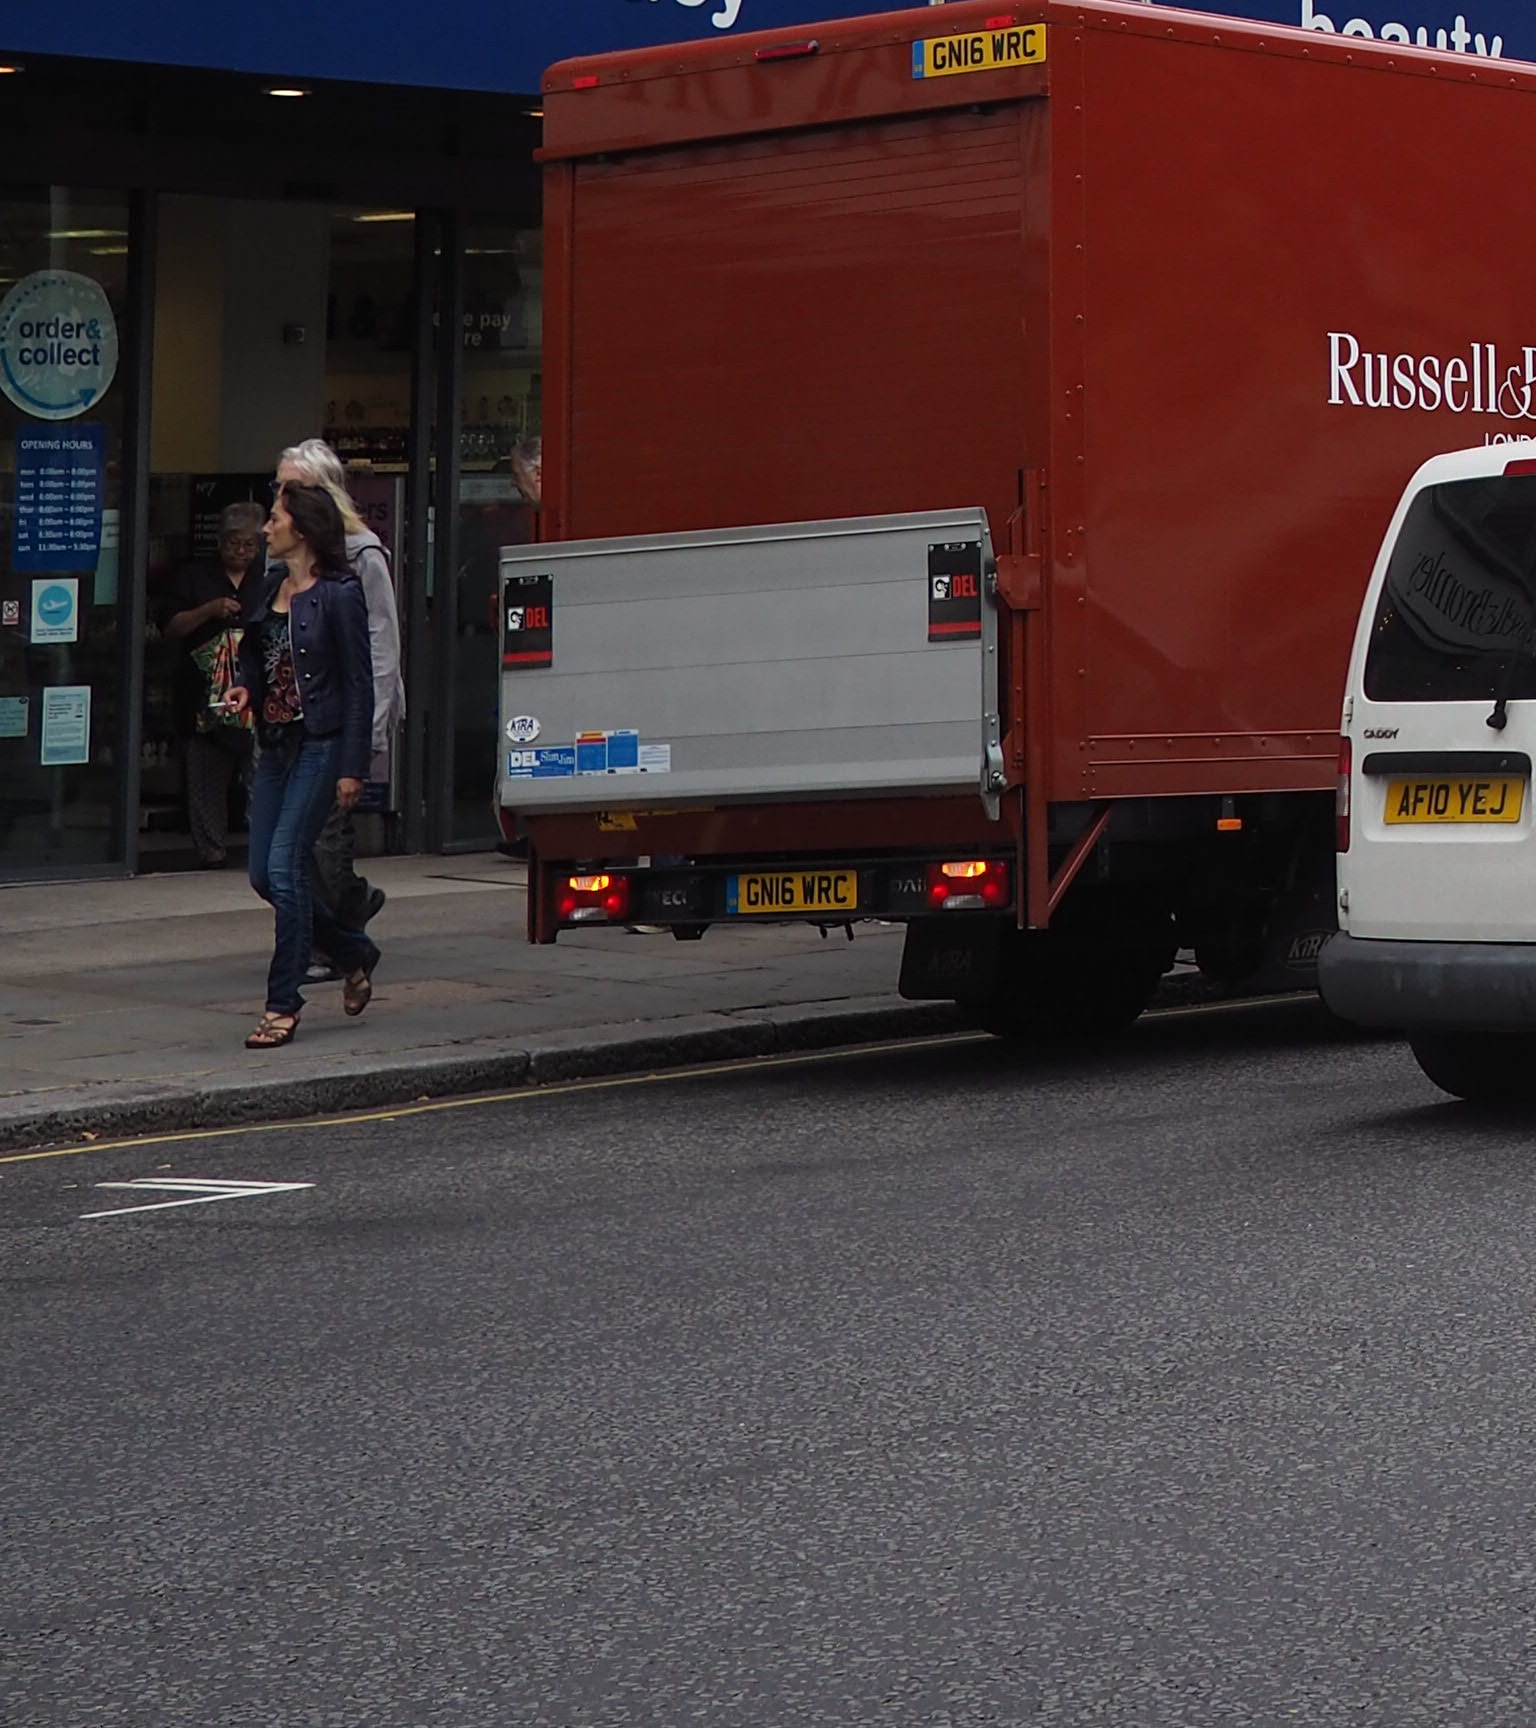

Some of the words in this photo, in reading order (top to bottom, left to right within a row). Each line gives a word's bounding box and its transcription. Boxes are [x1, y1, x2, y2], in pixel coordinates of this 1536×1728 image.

[933, 36, 985, 71] GN16
[991, 29, 1037, 62] WRC
[480, 313, 512, 332] pay
[463, 332, 482, 347] re
[18, 341, 101, 367] collect
[20, 439, 61, 450] OPENING
[62, 439, 94, 450] HOURS
[952, 574, 978, 598] DEL
[526, 606, 550, 629] DEL
[1363, 728, 1400, 740] CADDY
[510, 751, 541, 768] DEL
[1397, 783, 1450, 817] AF10
[1458, 783, 1508, 816] YEJ
[746, 878, 795, 906] GN16
[801, 875, 848, 905] WRC
